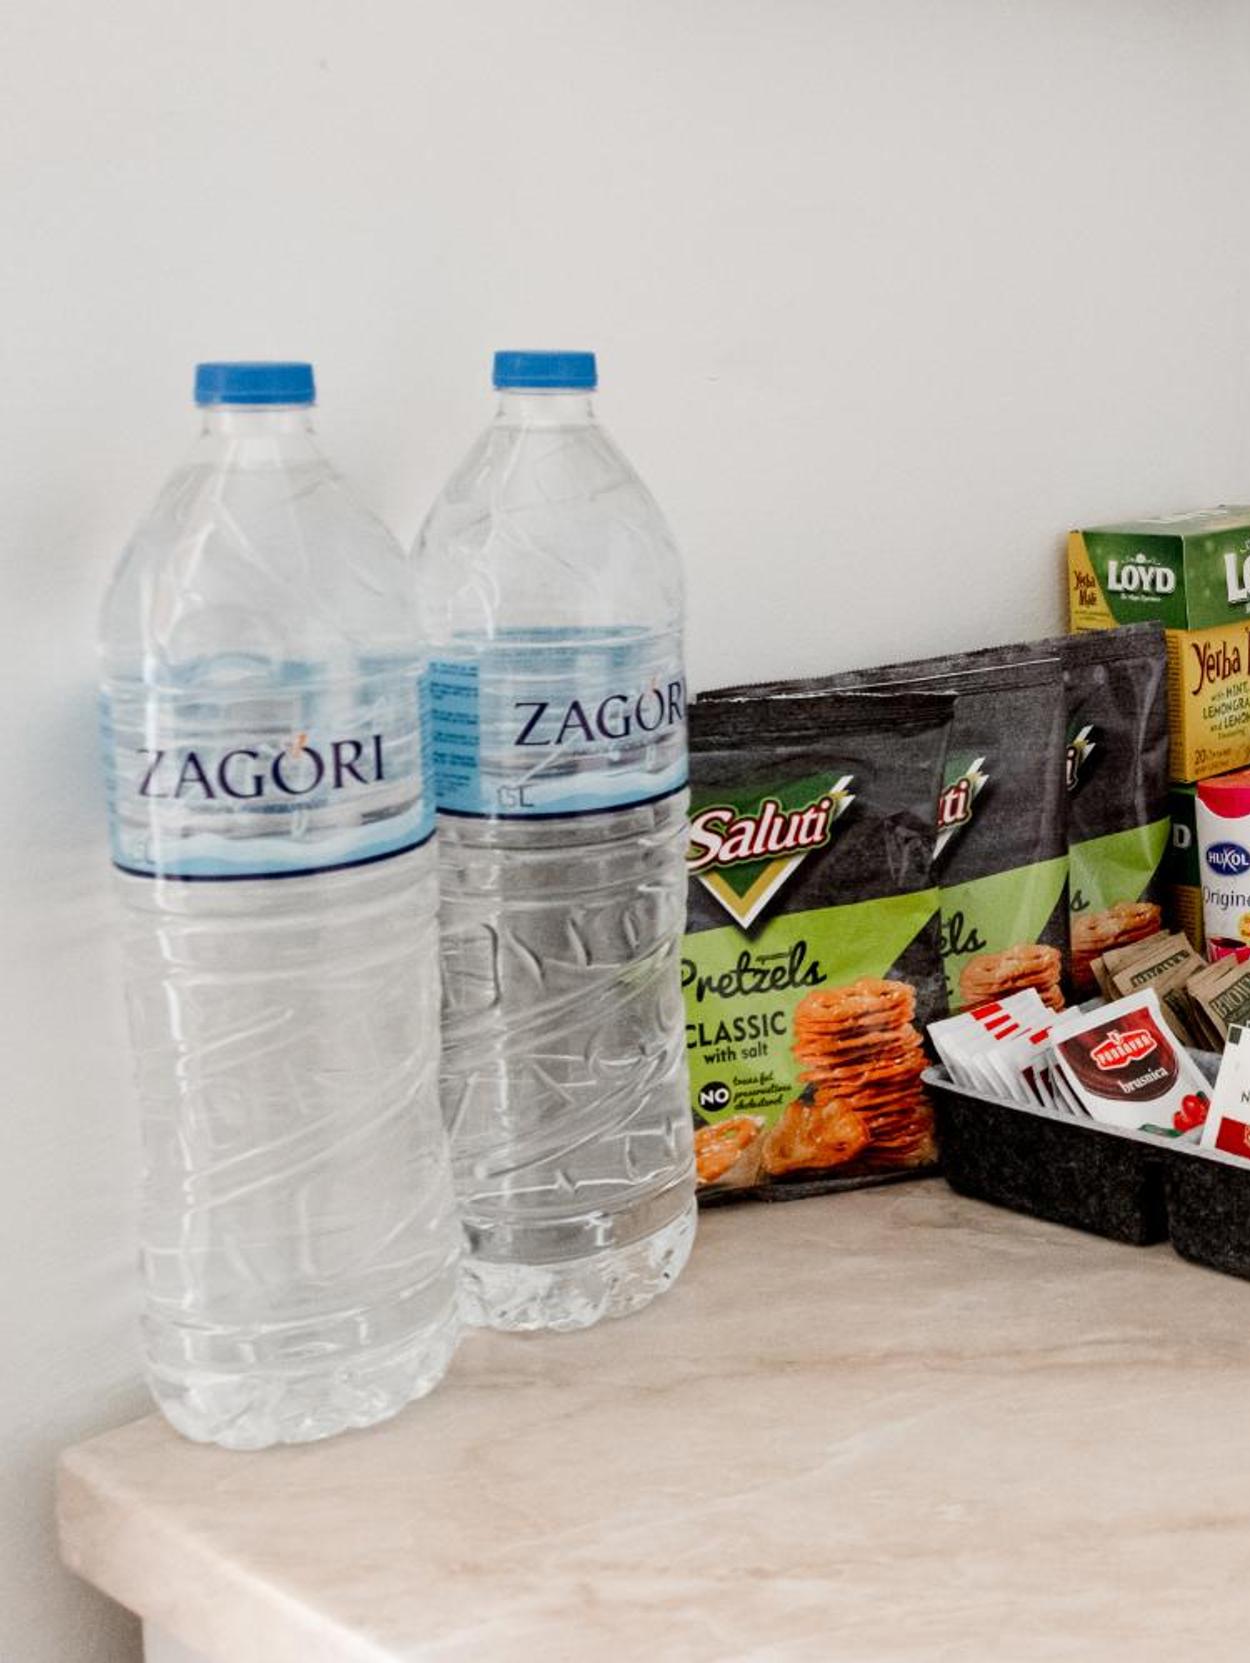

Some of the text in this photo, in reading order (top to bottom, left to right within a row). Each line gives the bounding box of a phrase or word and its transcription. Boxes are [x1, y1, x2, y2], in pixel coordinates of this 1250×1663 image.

[1107, 560, 1176, 594] LOYD
[1191, 642, 1241, 696] Yerba
[686, 798, 834, 871] Saluti
[1208, 848, 1250, 871] HUXOL
[704, 1041, 769, 1065] with salt
[1117, 1065, 1170, 1094] brusnica
[700, 1087, 730, 1106] NO
